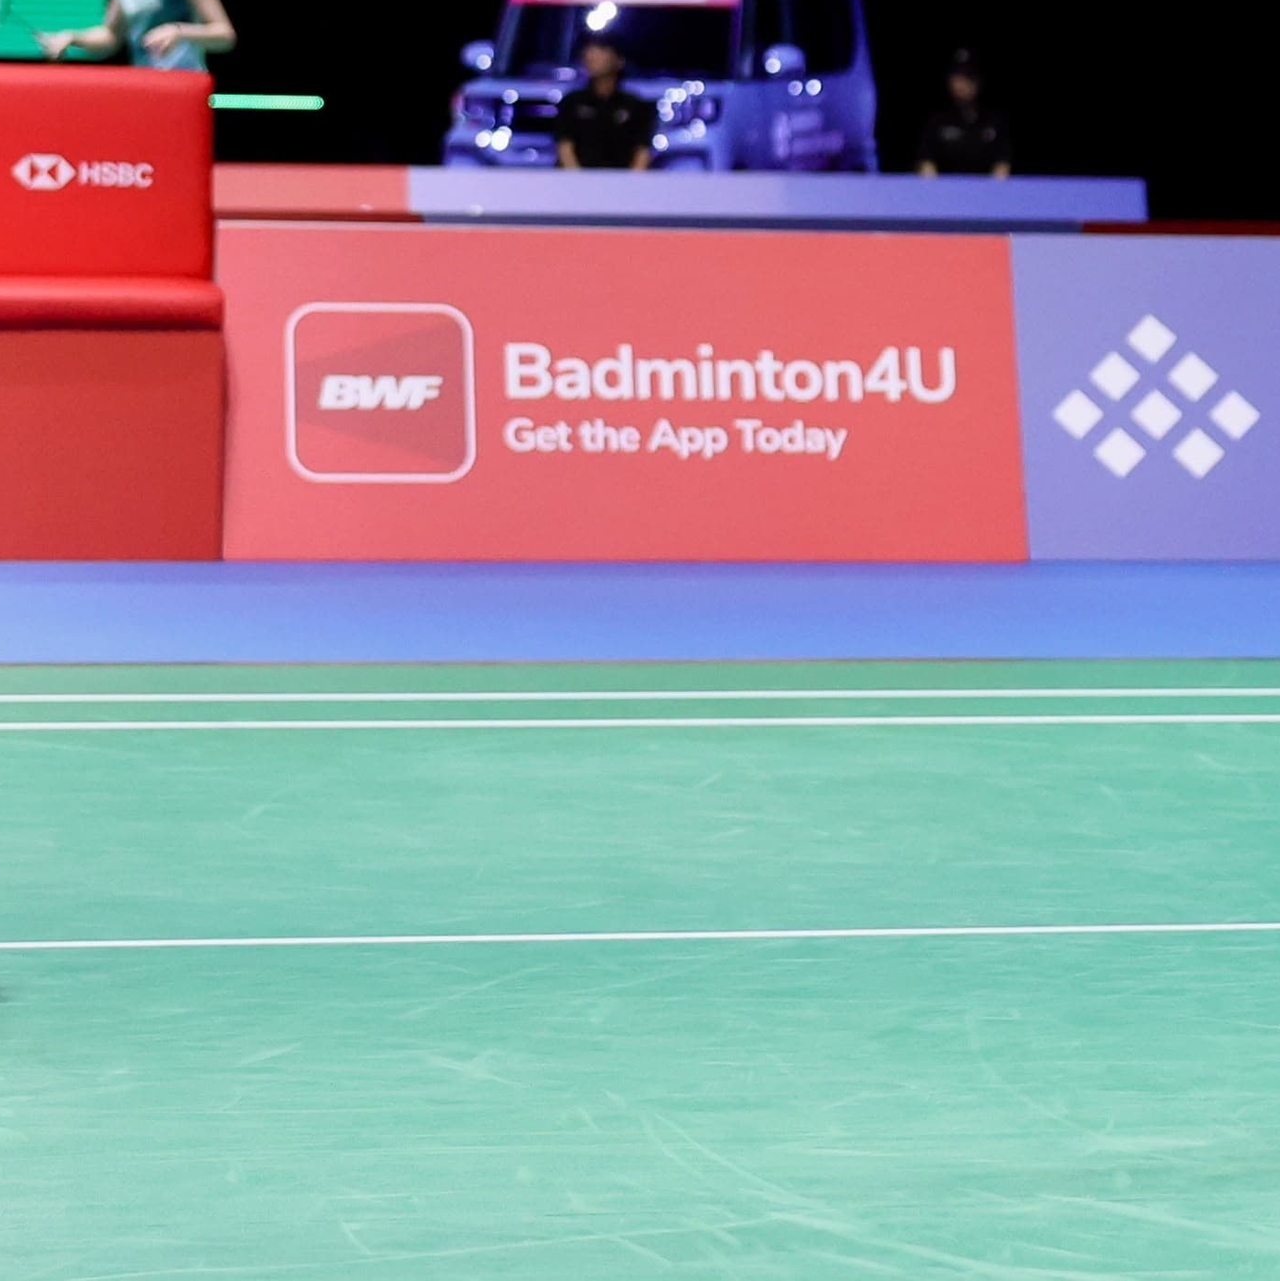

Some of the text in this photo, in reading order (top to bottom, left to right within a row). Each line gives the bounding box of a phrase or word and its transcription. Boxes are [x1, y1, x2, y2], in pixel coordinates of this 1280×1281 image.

[78, 159, 153, 188] HSBC
[319, 375, 443, 411] BWF
[503, 342, 956, 404] Badminton4U
[503, 417, 847, 461] Get the App Today
